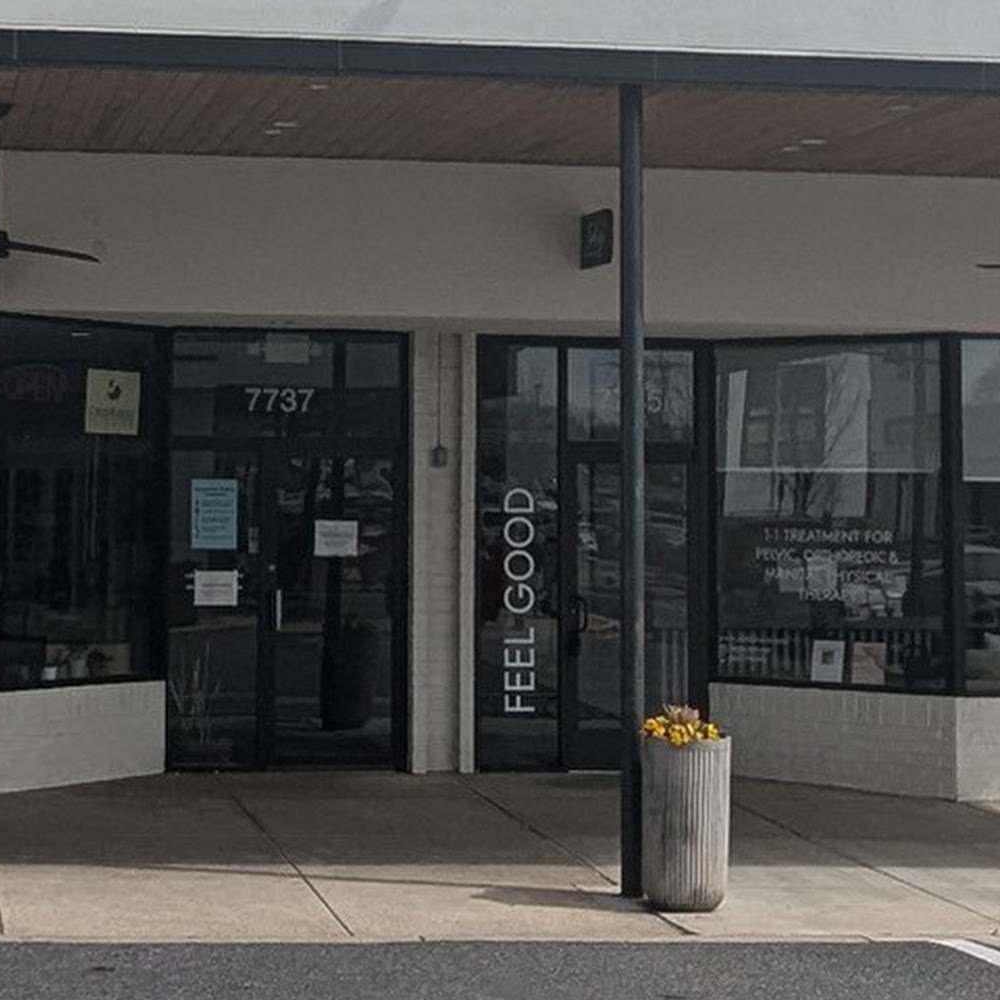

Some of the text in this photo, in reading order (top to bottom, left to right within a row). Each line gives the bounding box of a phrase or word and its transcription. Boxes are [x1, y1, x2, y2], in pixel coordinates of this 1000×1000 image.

[245, 387, 315, 413] 7737
[784, 528, 860, 544] TREATMENT
[864, 529, 894, 545] FOR
[503, 487, 536, 713] FEEL GOOD
